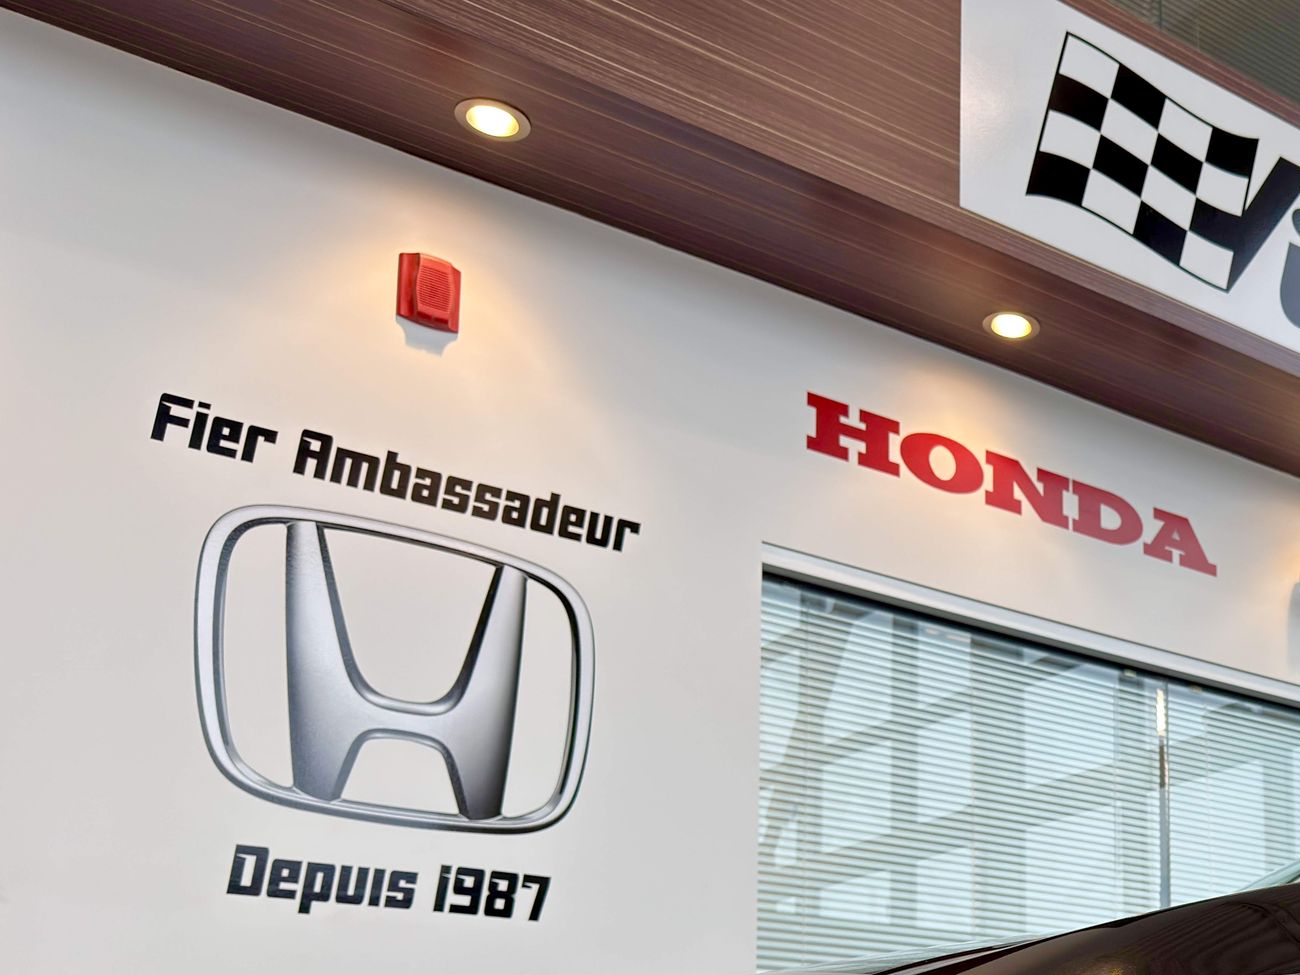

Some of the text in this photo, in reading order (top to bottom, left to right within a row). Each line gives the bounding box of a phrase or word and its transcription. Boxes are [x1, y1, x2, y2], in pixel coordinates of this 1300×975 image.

[150, 392, 641, 552] Fier Ambassadeur
[806, 392, 1218, 577] HONDA
[226, 844, 552, 922] Depuis 1987
